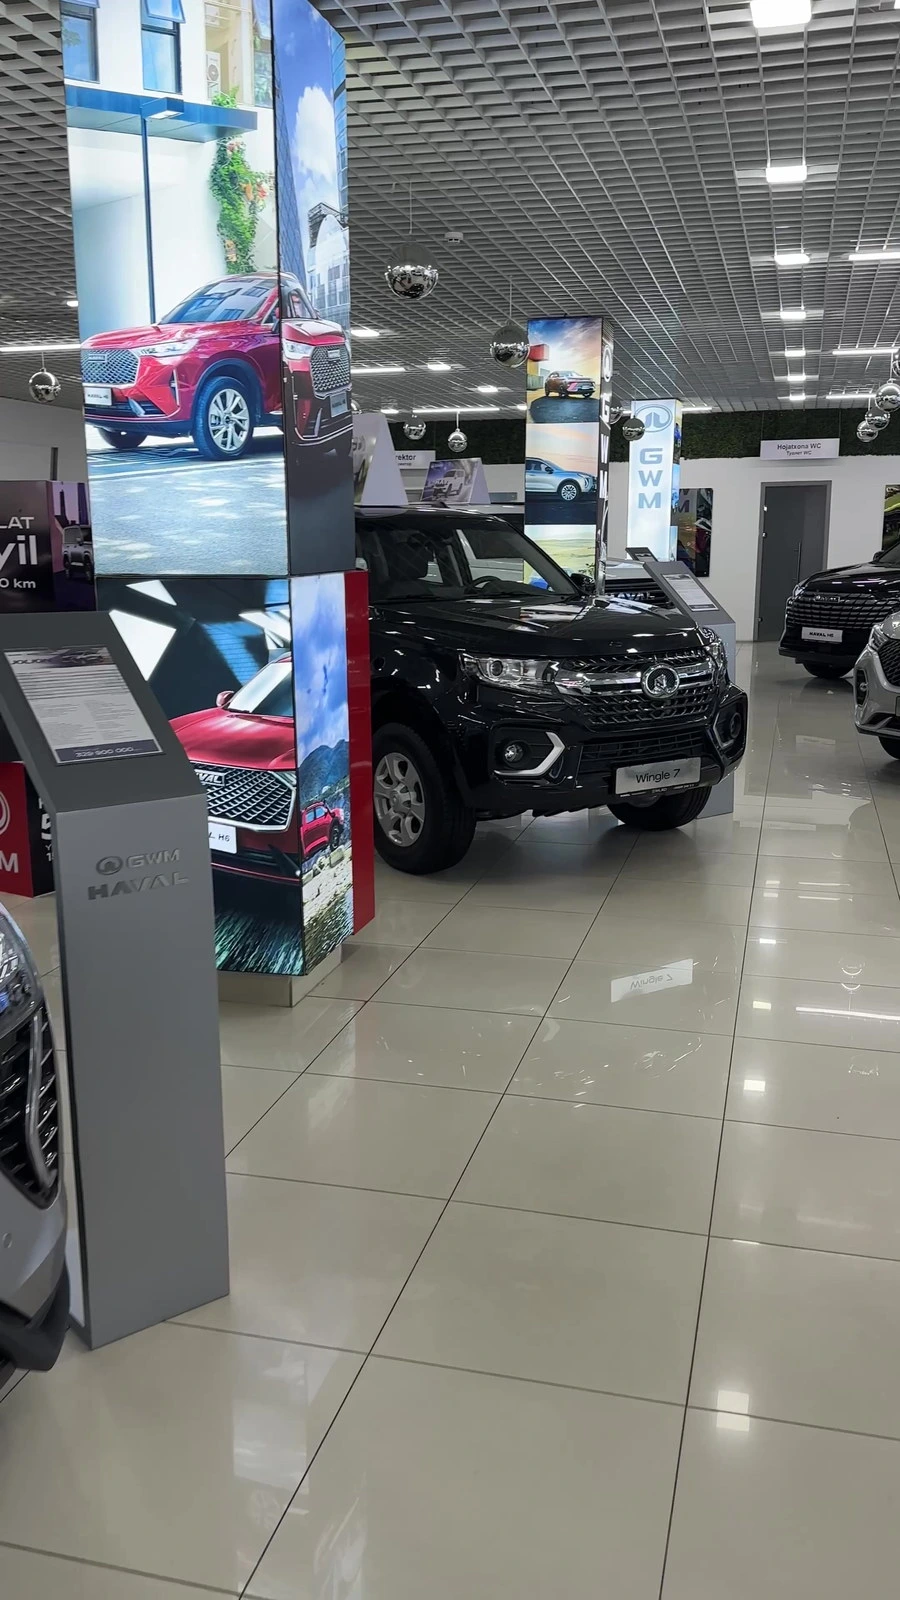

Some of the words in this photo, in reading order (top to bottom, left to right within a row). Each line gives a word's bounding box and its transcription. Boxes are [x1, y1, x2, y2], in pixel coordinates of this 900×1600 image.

[638, 448, 663, 509] GWM
[13, 578, 36, 588] km
[196, 772, 222, 783] VAL
[636, 771, 670, 783] Wingle
[673, 769, 680, 778] 7
[126, 848, 181, 869] GWM
[87, 872, 190, 900] HAVAL
